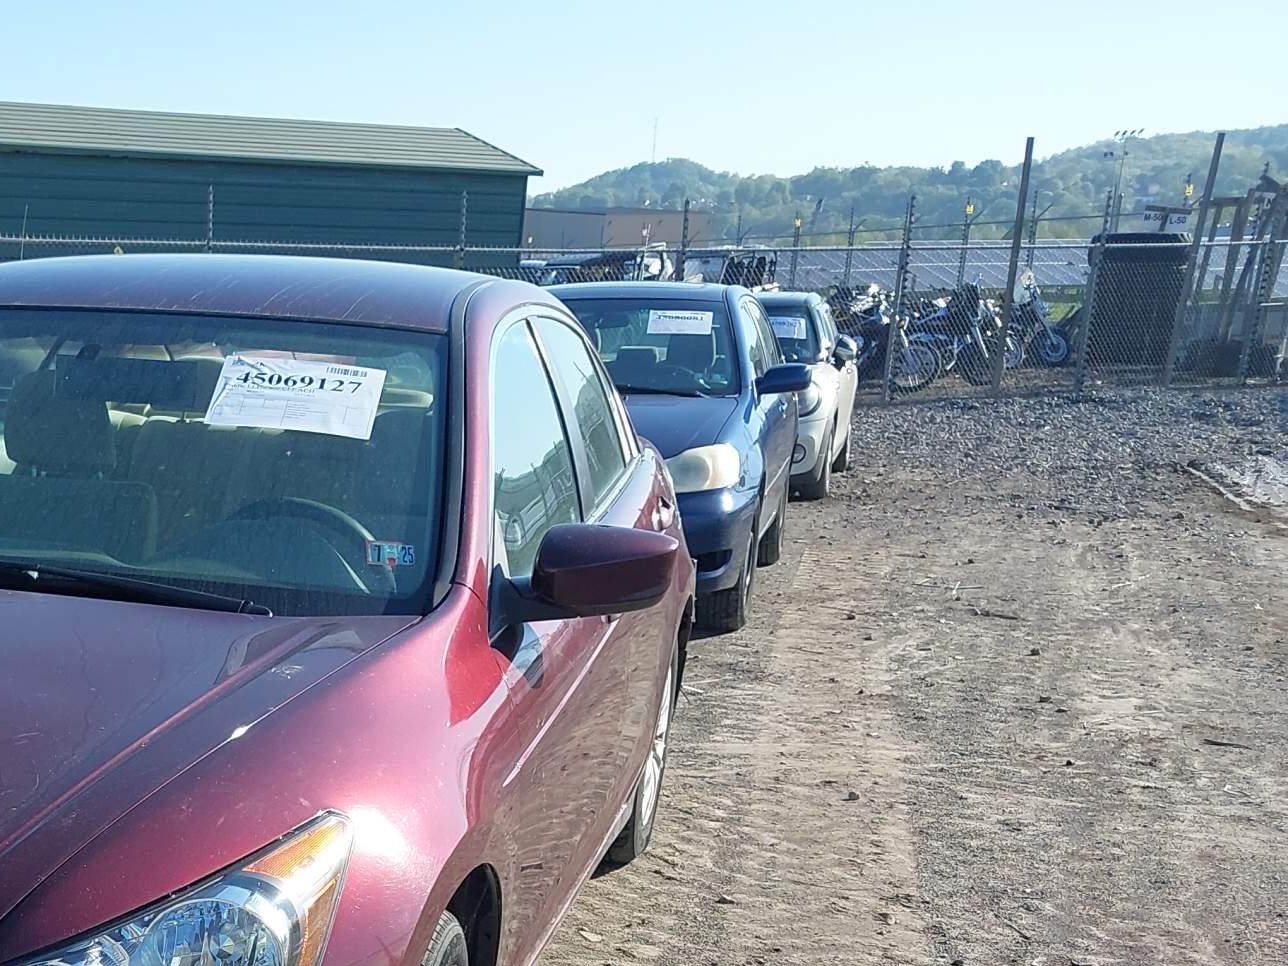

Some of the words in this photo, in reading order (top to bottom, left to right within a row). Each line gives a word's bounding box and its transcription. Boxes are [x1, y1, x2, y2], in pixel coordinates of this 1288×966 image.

[1169, 215, 1187, 225] L-50
[237, 371, 363, 394] 45069127
[401, 544, 415, 564] 25
